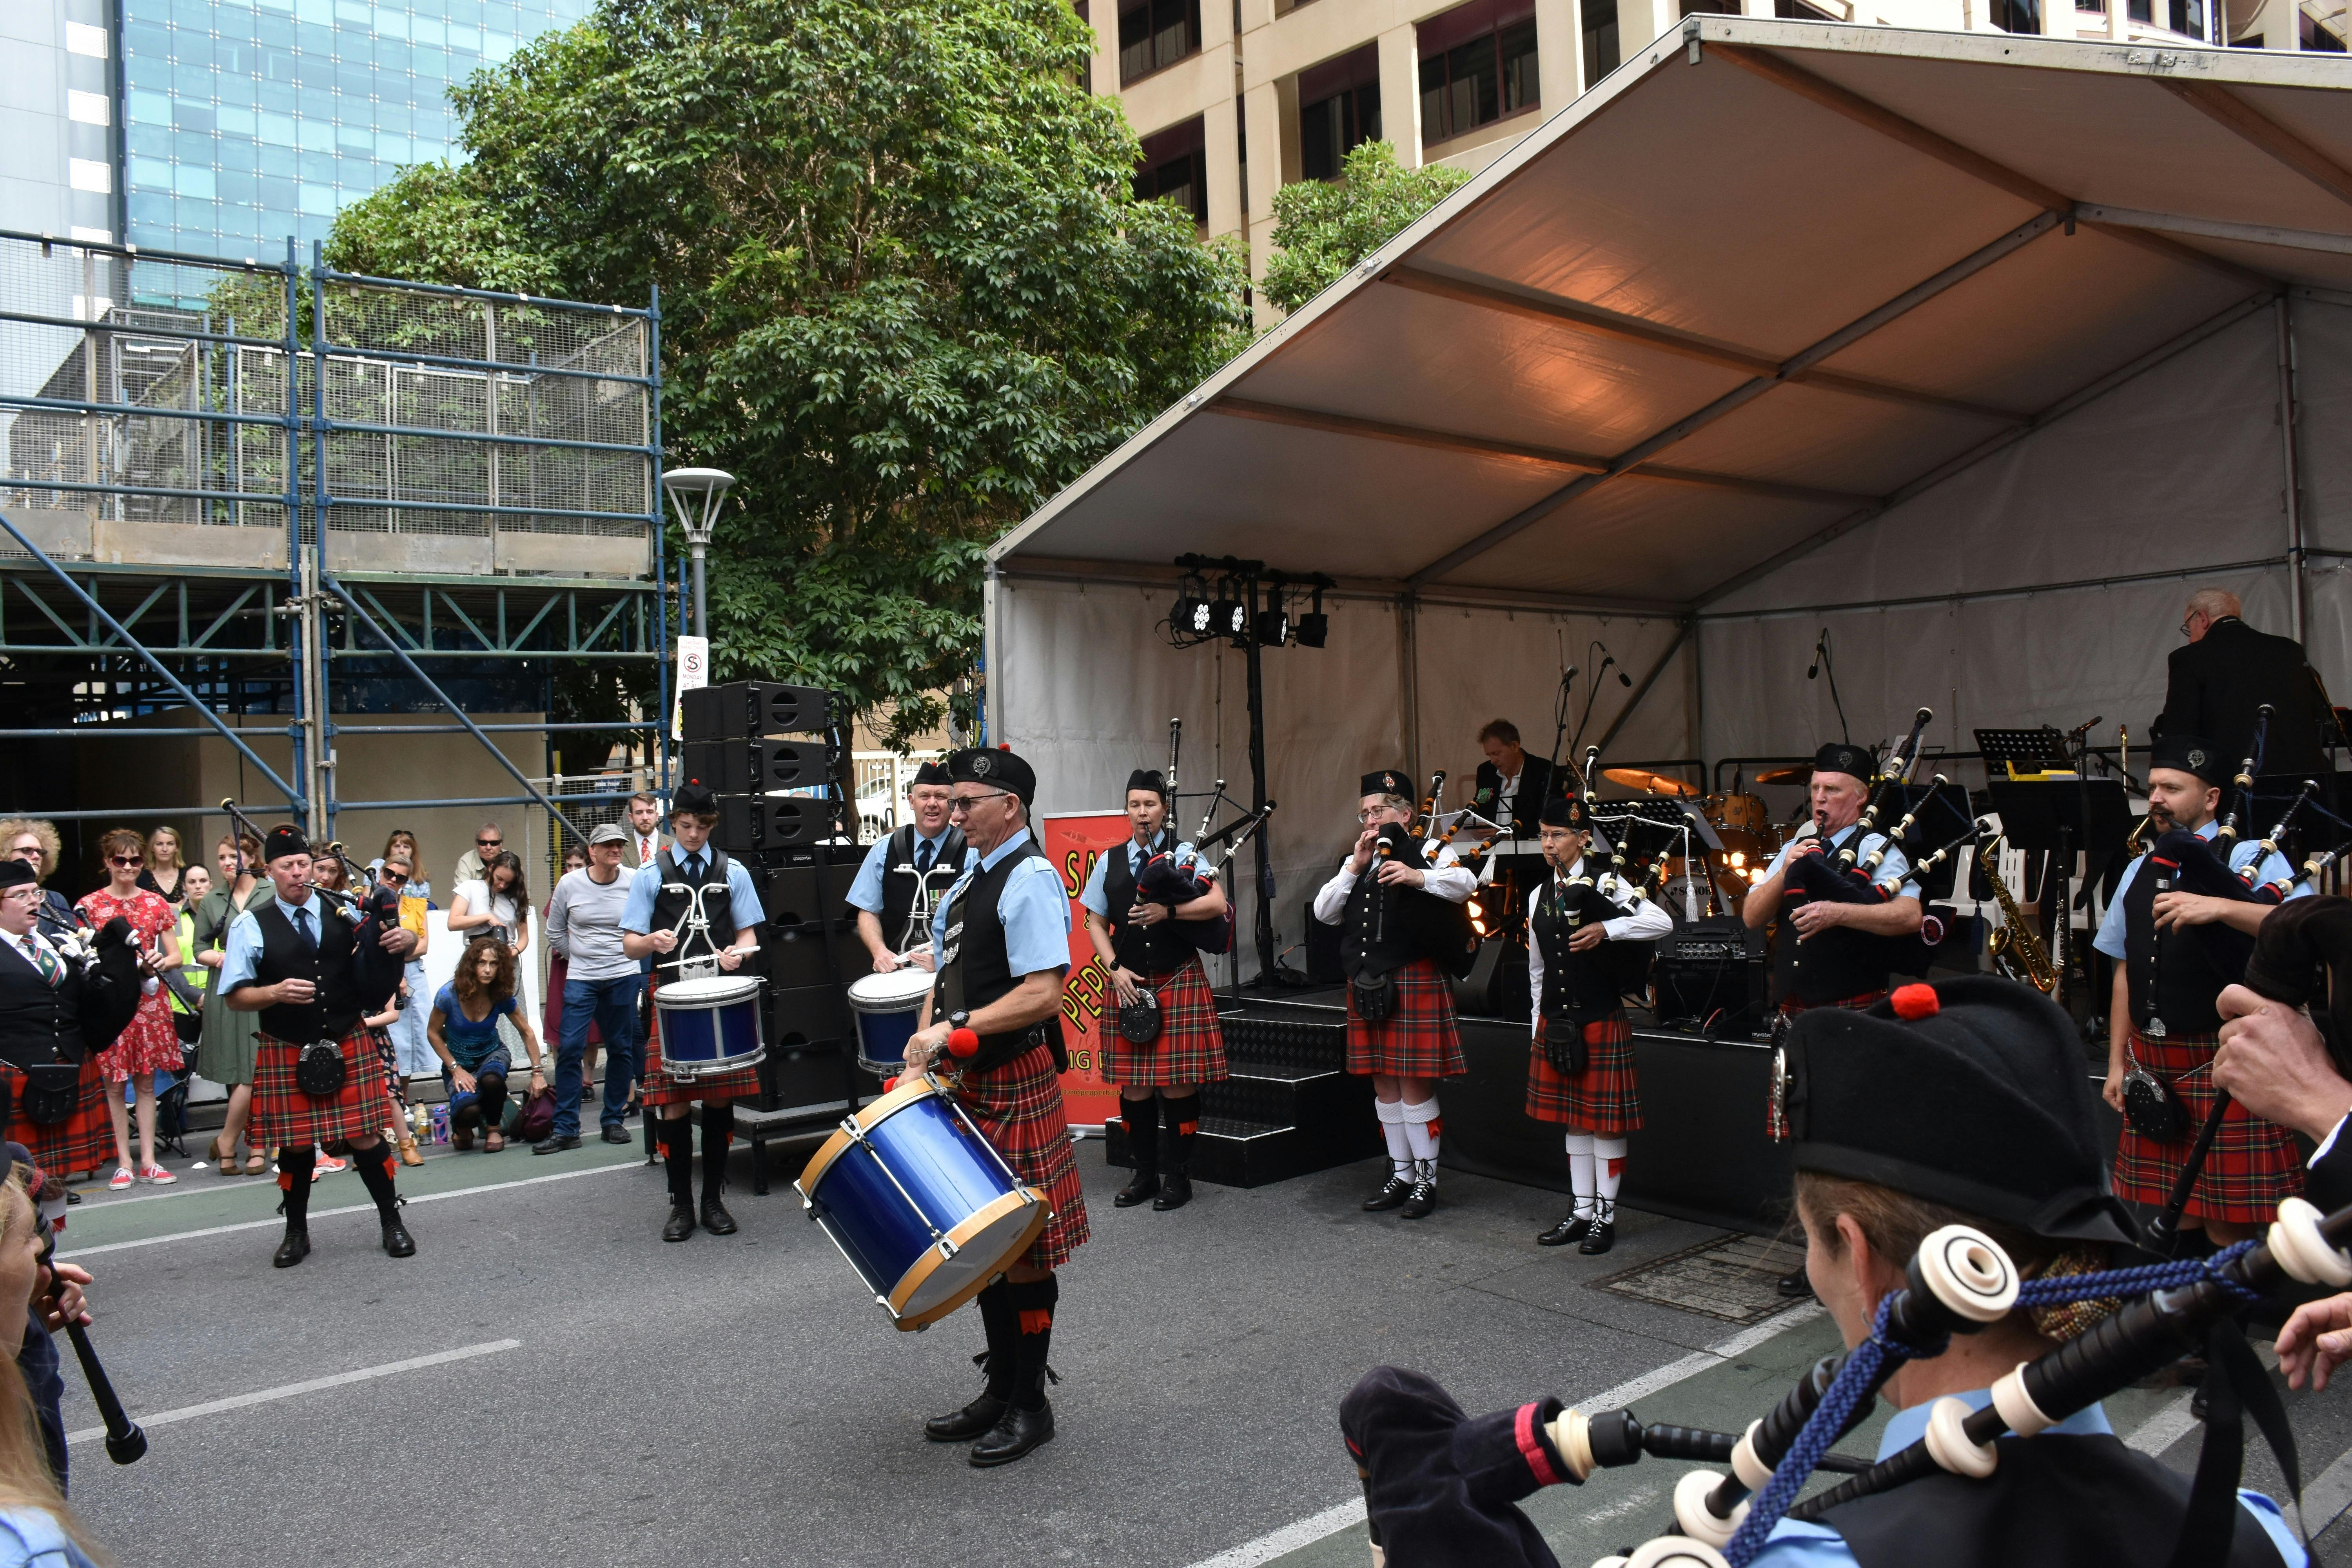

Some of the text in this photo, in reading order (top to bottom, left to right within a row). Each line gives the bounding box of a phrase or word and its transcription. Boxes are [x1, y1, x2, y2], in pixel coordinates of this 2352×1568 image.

[1065, 850, 1098, 899] SA
[1679, 886, 1711, 895] SNOR
[1069, 1050, 1091, 1070] IG
[1062, 1088, 1121, 1097] ltandpepperbigb
